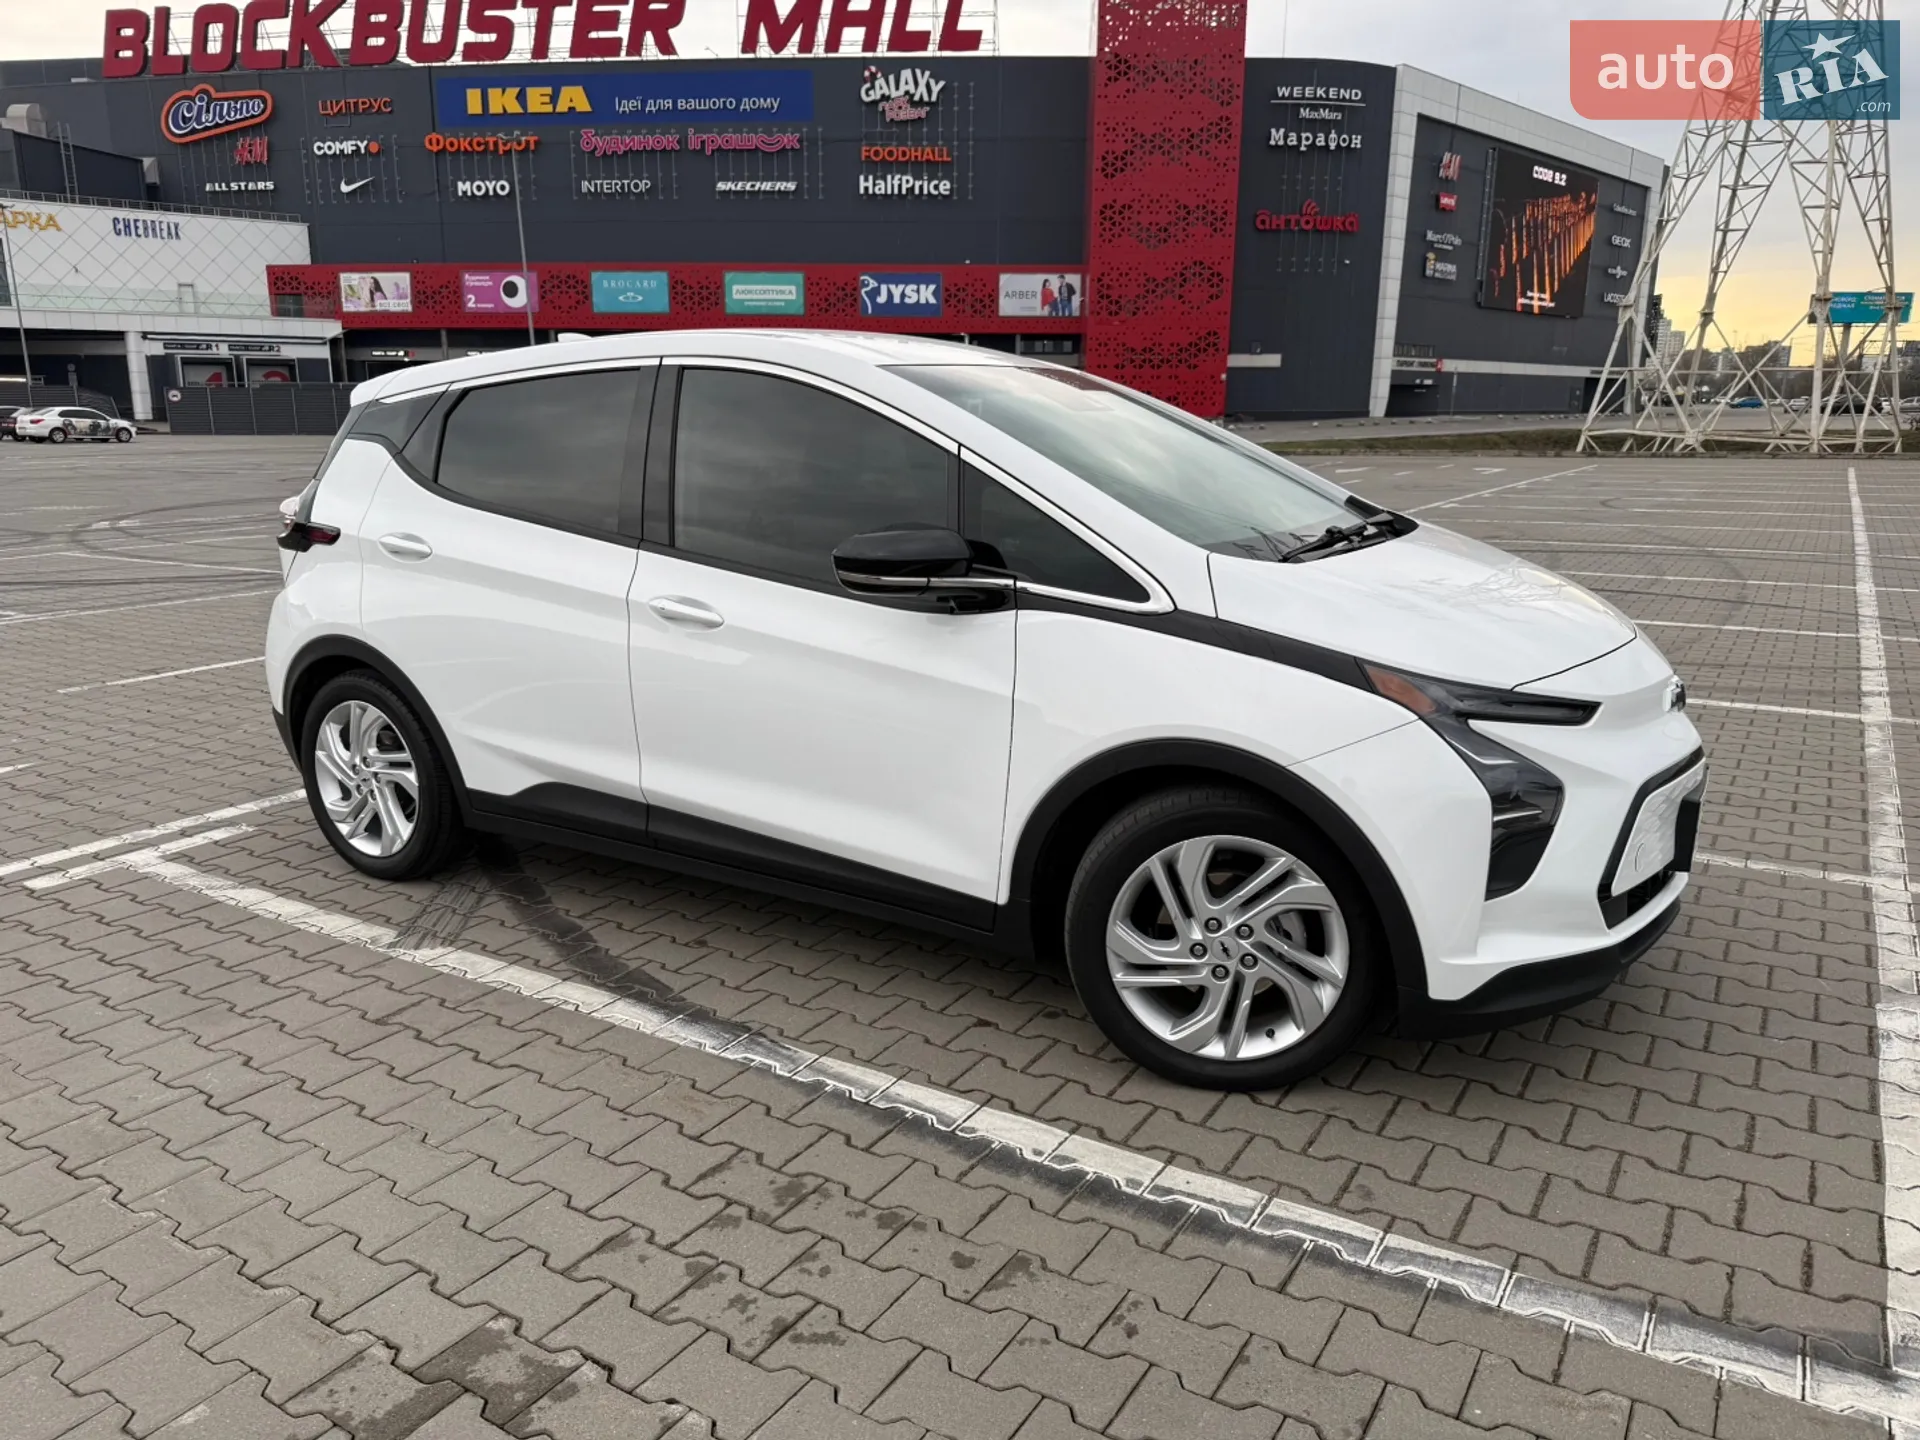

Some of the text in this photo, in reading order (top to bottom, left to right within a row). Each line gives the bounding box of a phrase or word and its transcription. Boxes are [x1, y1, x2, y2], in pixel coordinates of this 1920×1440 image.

[102, 0, 983, 79] BLOCKBUSTER MALL
[860, 68, 946, 102] GALAXY
[1277, 86, 1362, 100] WEEKEND
[318, 97, 392, 116] ЦИТРУС
[465, 85, 592, 115] IKEA
[615, 96, 781, 114] Ідеї для вашого дому
[168, 94, 264, 134] Сільпо
[1299, 107, 1342, 120] MaxMara
[313, 140, 368, 155] COMFY
[424, 132, 538, 154] Фокстрот
[580, 129, 680, 157] будинок
[1269, 128, 1362, 150] Марафон
[234, 136, 268, 165] H&M
[861, 146, 951, 161] FOODHALL
[205, 181, 274, 192] ALL STARS
[457, 180, 510, 197] MOYO
[581, 179, 651, 193] INTERTOP
[715, 181, 798, 192] SKECHERS
[859, 174, 951, 195] HalfPrice
[112, 217, 181, 240] CHEBREAK
[602, 280, 657, 288] BROCARD
[735, 288, 794, 296] ЛЮКСОПТИКА
[876, 283, 937, 304] JYSK
[1004, 290, 1037, 300] ARBER
